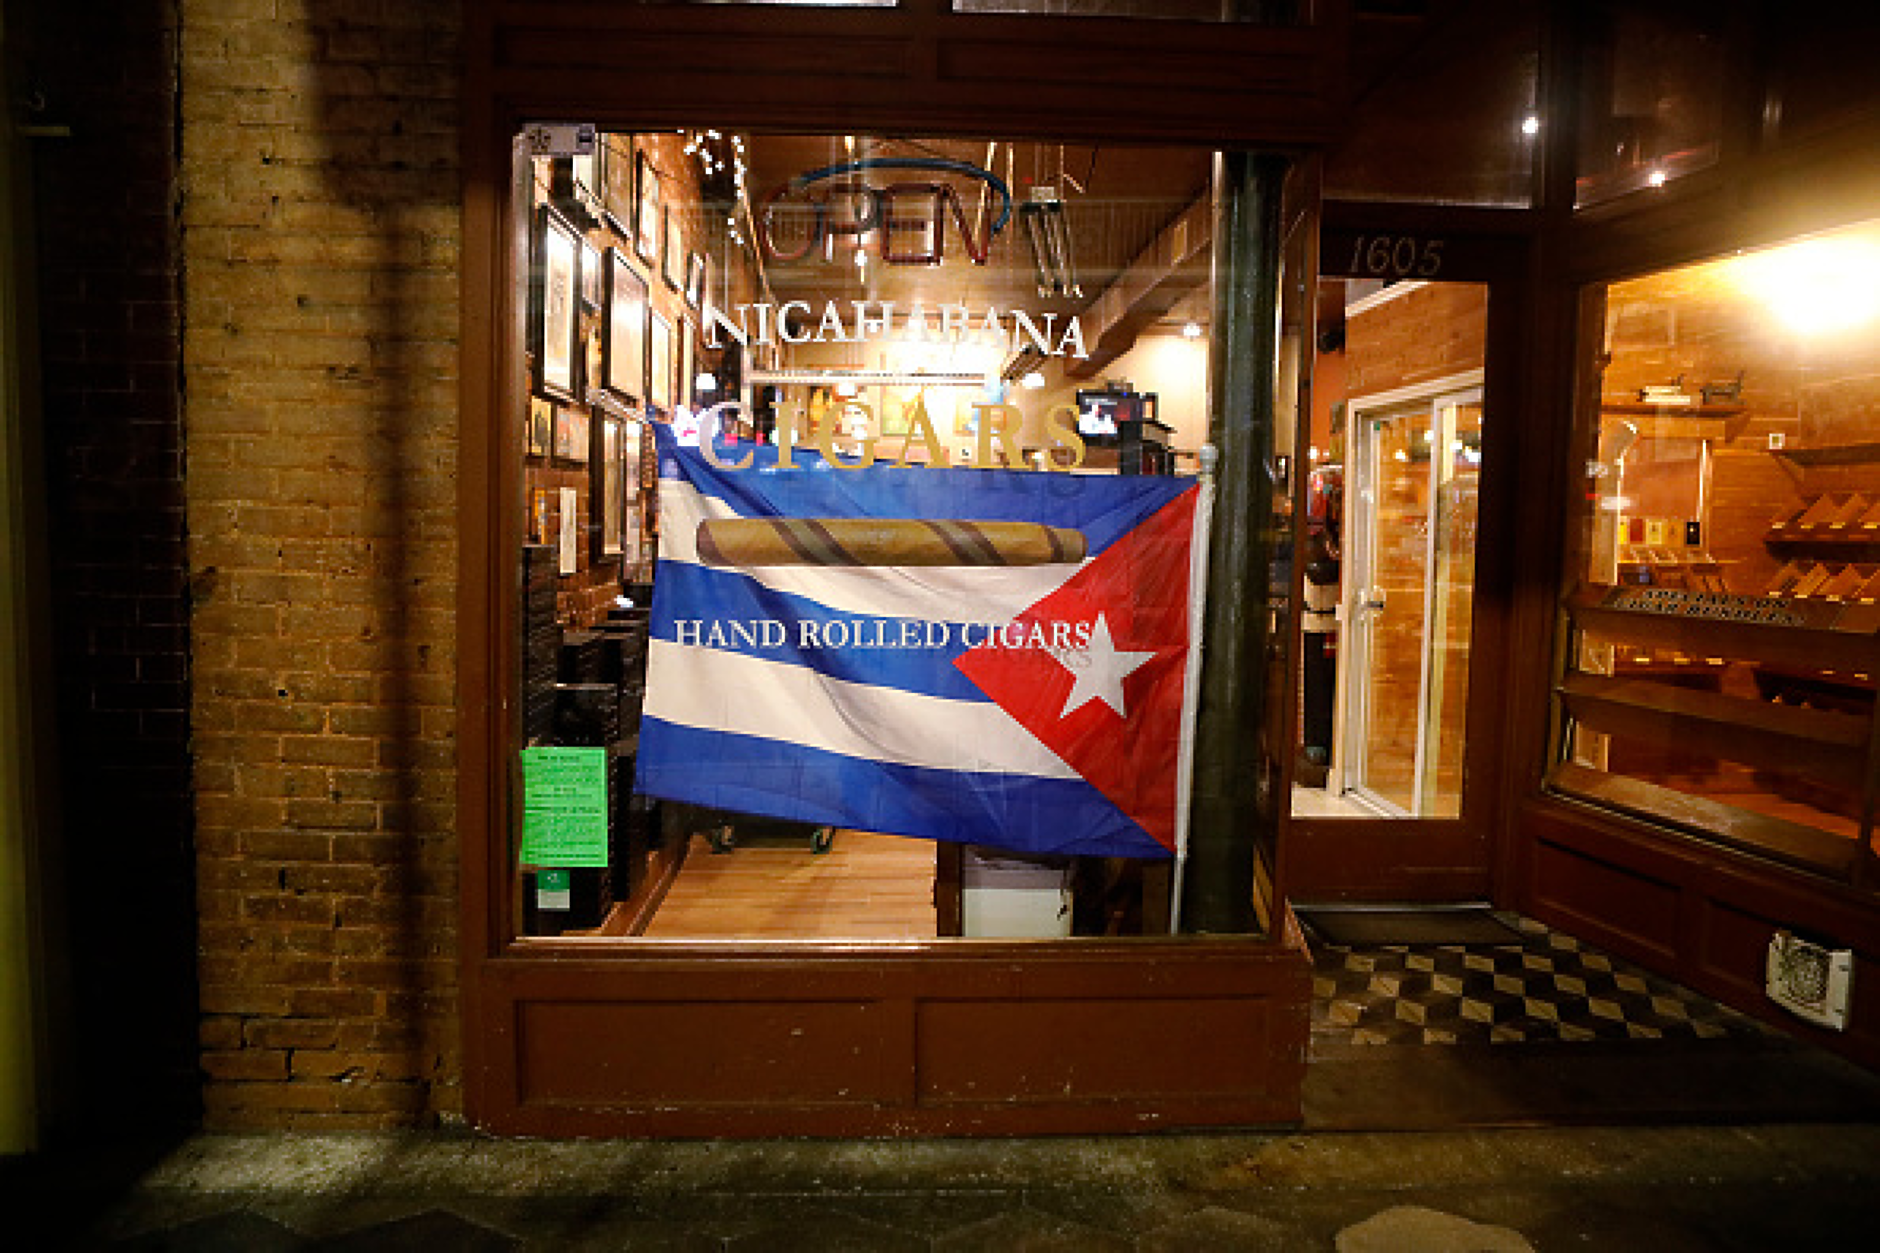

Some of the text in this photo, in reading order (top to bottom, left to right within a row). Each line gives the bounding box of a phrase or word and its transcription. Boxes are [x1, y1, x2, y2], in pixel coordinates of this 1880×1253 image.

[757, 181, 993, 266] OPEN
[1349, 234, 1444, 276] 1605
[699, 391, 1087, 470] CIGARS
[673, 619, 1092, 650] HAND ROLLED CIGARS
